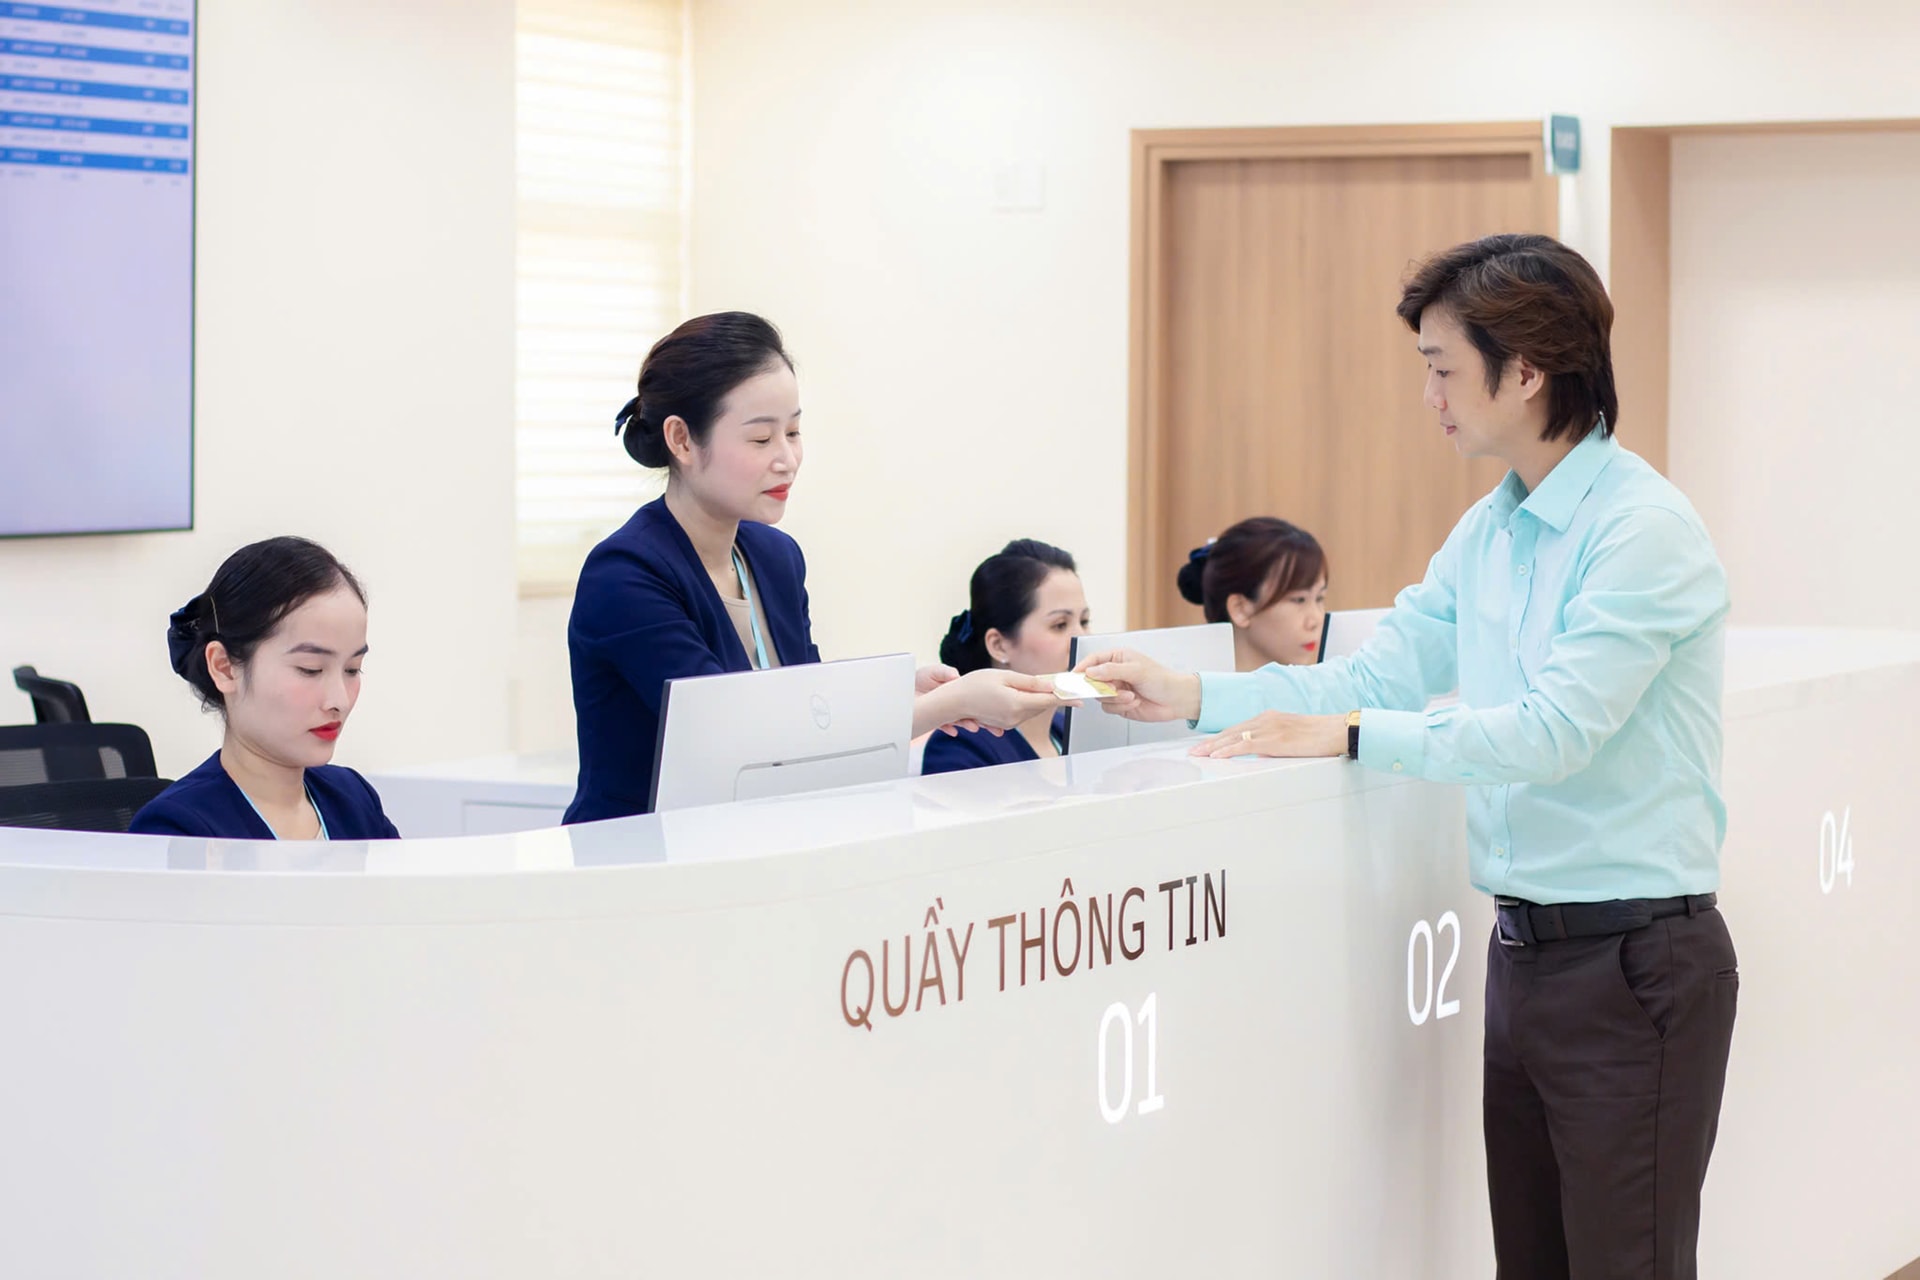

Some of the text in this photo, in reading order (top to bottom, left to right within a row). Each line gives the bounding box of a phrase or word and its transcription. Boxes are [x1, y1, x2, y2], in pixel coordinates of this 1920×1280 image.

[1819, 804, 1855, 895] 04
[840, 869, 1227, 1032] QUẦY THÔNG TIN
[1407, 910, 1461, 1026] 02
[1098, 991, 1165, 1124] 01
